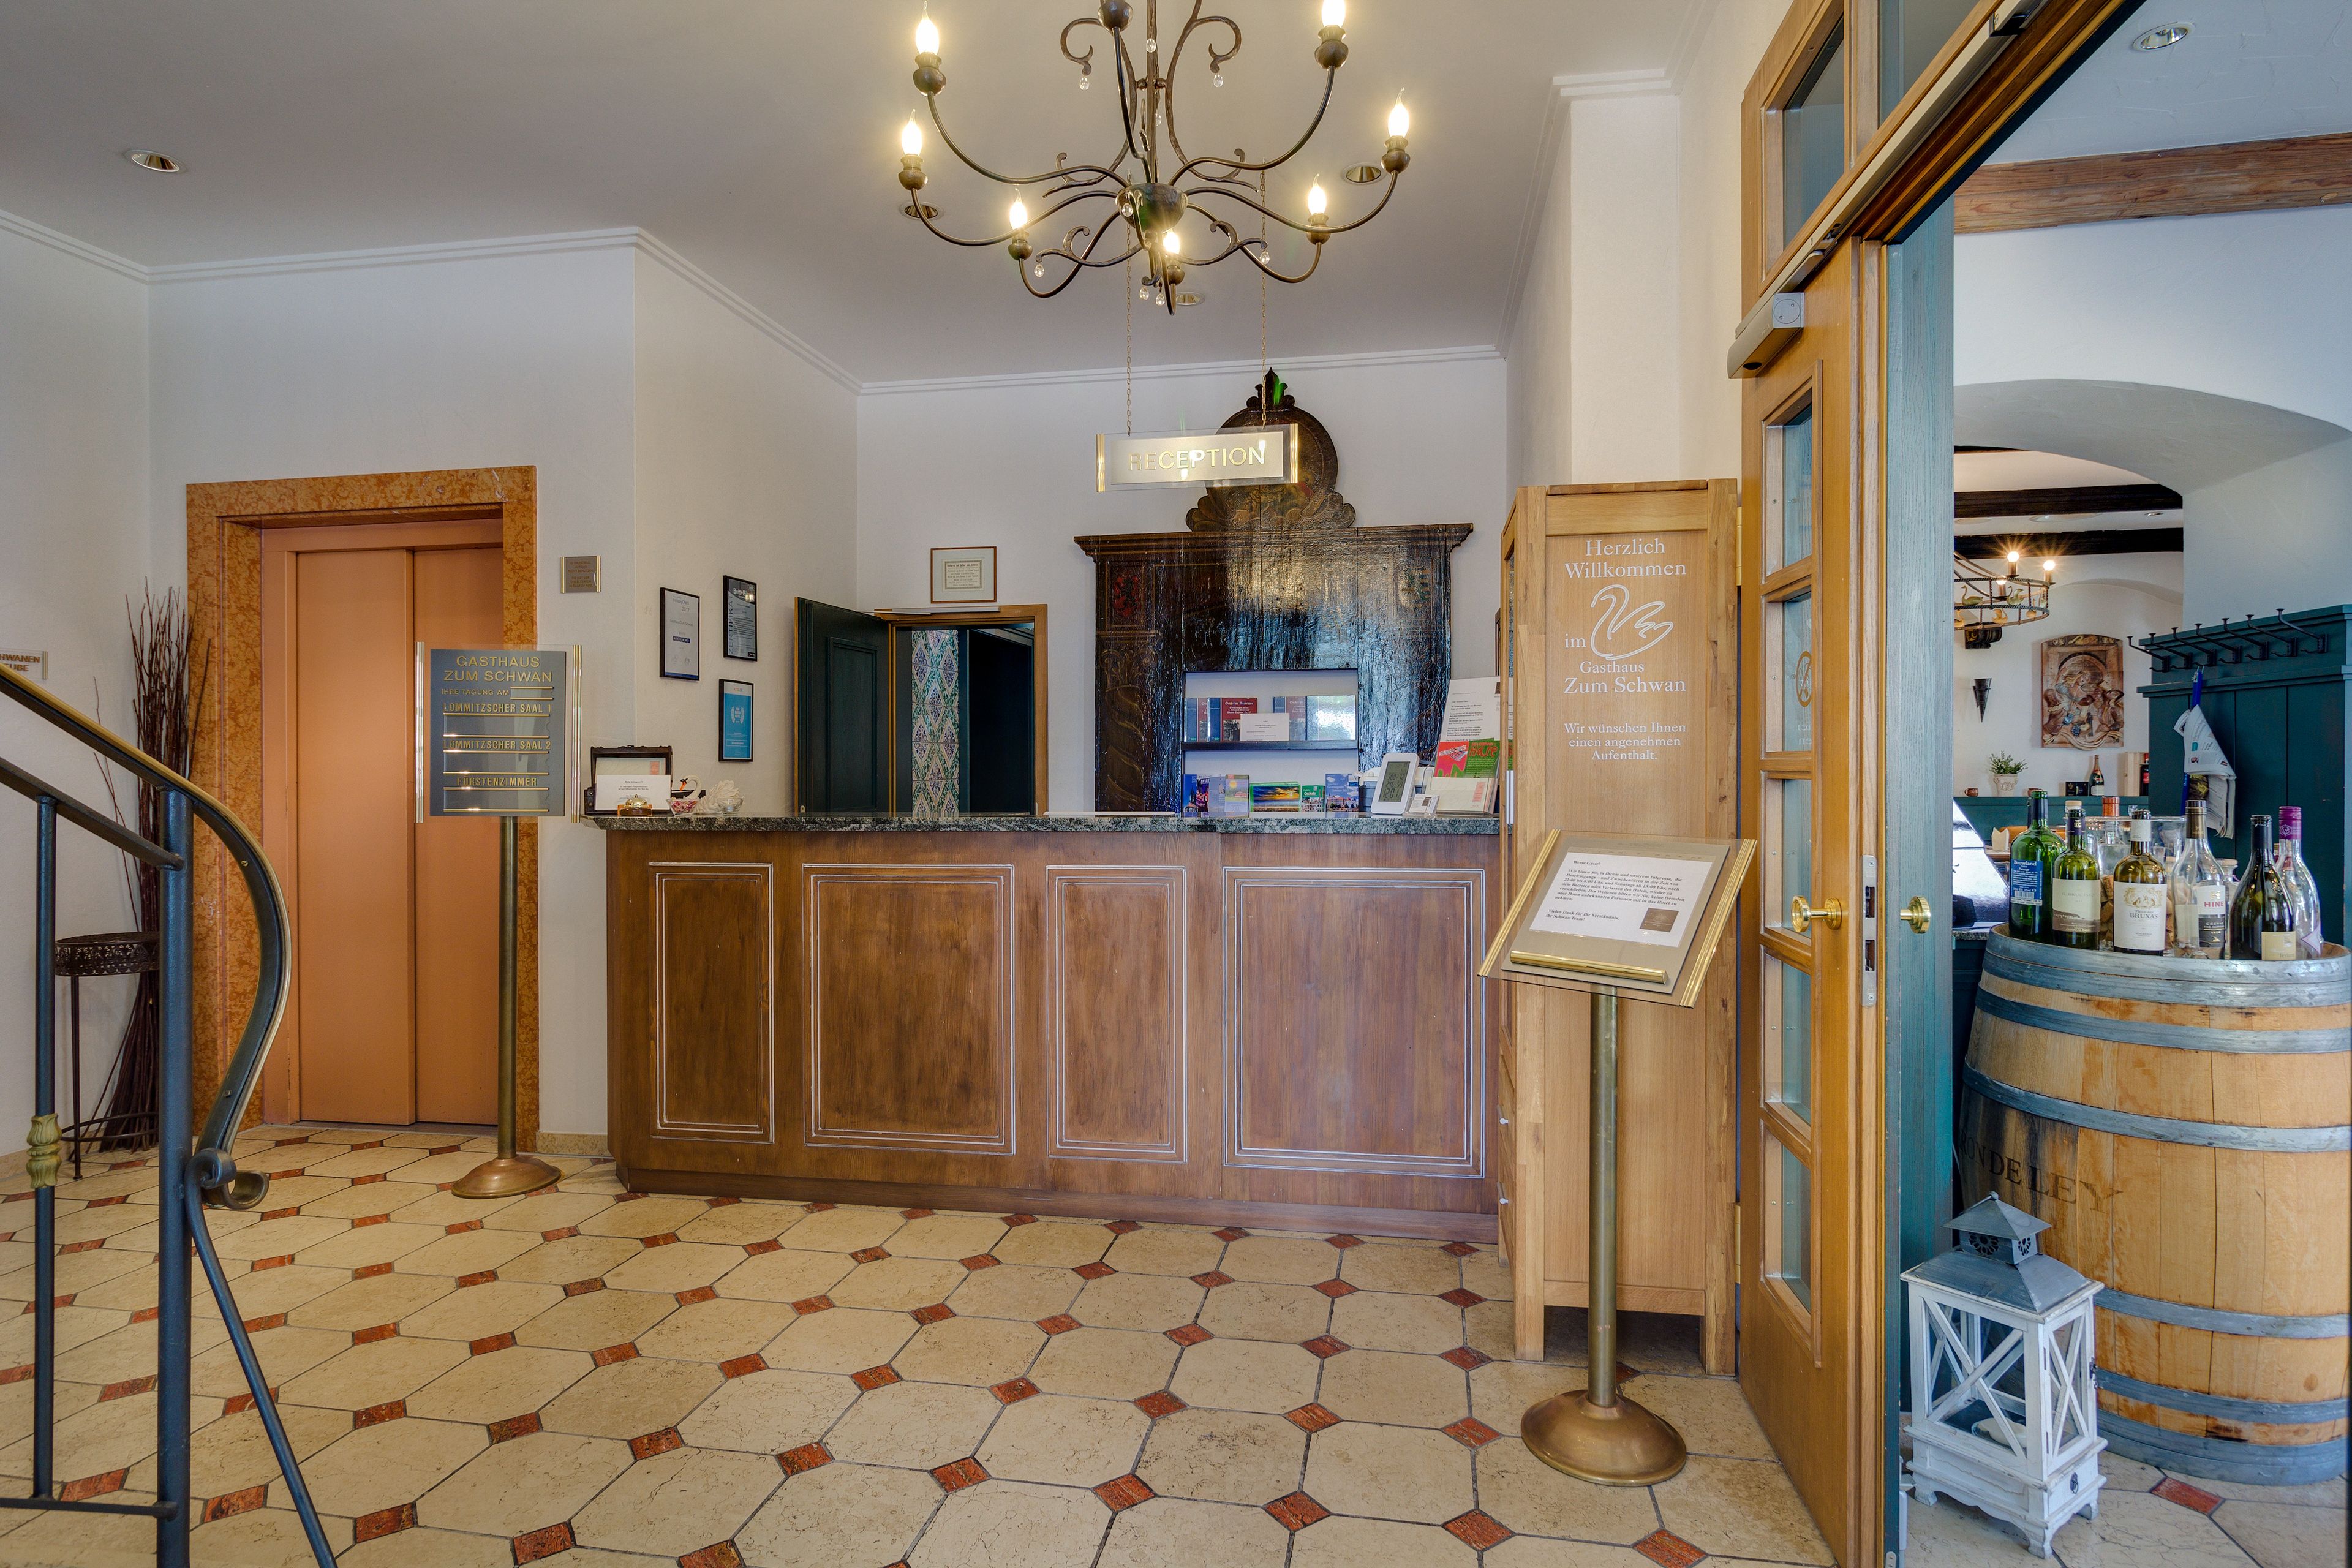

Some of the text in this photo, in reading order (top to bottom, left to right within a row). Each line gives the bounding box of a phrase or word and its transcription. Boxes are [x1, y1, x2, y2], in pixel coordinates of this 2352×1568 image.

[1128, 447, 1265, 472] RECEPTION
[1585, 538, 1666, 556] Herzlich
[1564, 562, 1687, 578] Willkommen
[1564, 633, 1586, 648] im
[0, 654, 40, 663] HWANEN
[456, 656, 540, 668] GASTHAUS
[1580, 660, 1645, 674] Gasthaus
[443, 670, 552, 682] ZUM SCHWAN
[1564, 676, 1686, 693] Zum Schwan
[443, 703, 516, 712] LOMMITZSCHER
[520, 704, 543, 713] SAAL
[1564, 722, 1686, 734] Wir wünschen Ihnen
[443, 740, 551, 750] LOMMITZSCHER SAAL 2
[1569, 736, 1681, 748] einen angenehmen
[1592, 750, 1657, 760] Aufenthalt.
[457, 775, 537, 786] FÜRSTENZIMMER
[1989, 1149, 2022, 1186] DE
[2027, 1164, 2124, 1215] LEY
